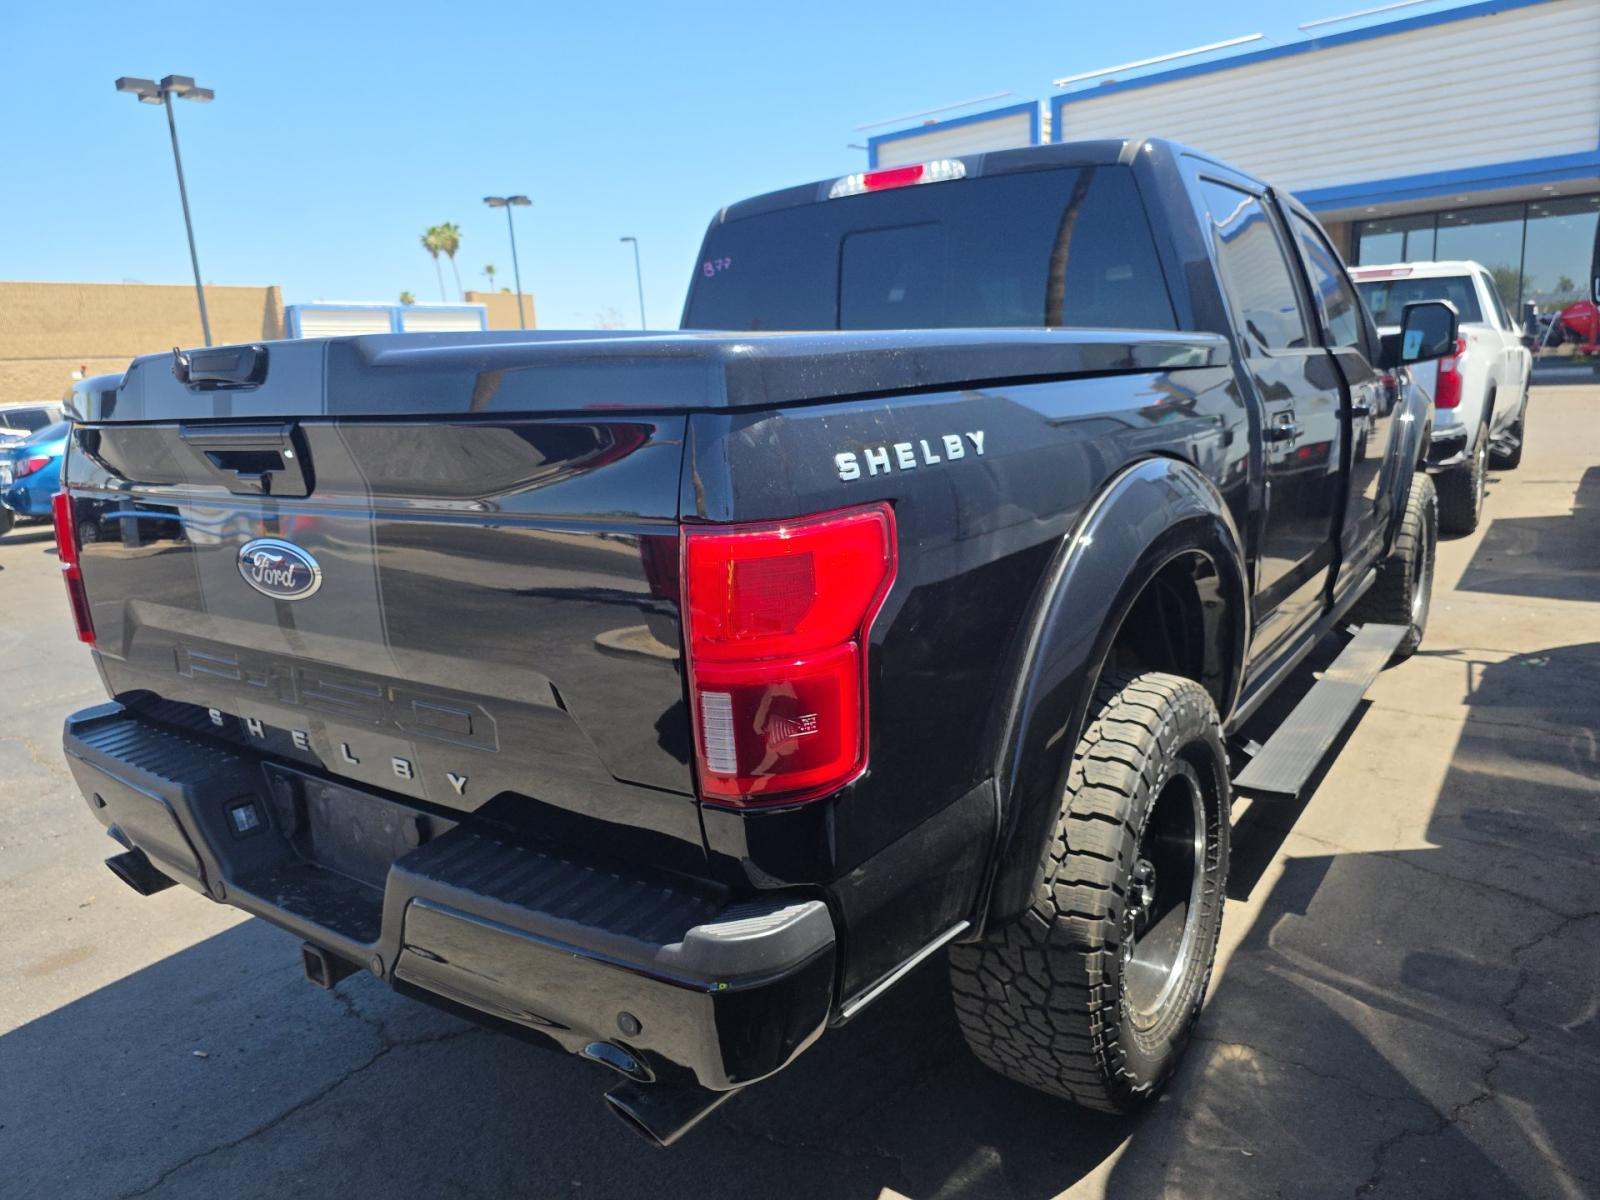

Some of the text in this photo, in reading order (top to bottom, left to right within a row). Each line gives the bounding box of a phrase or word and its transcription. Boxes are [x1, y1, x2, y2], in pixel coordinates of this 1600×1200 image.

[834, 430, 985, 481] SHELBY
[251, 551, 297, 588] Ford
[208, 707, 468, 796] SHELBY
